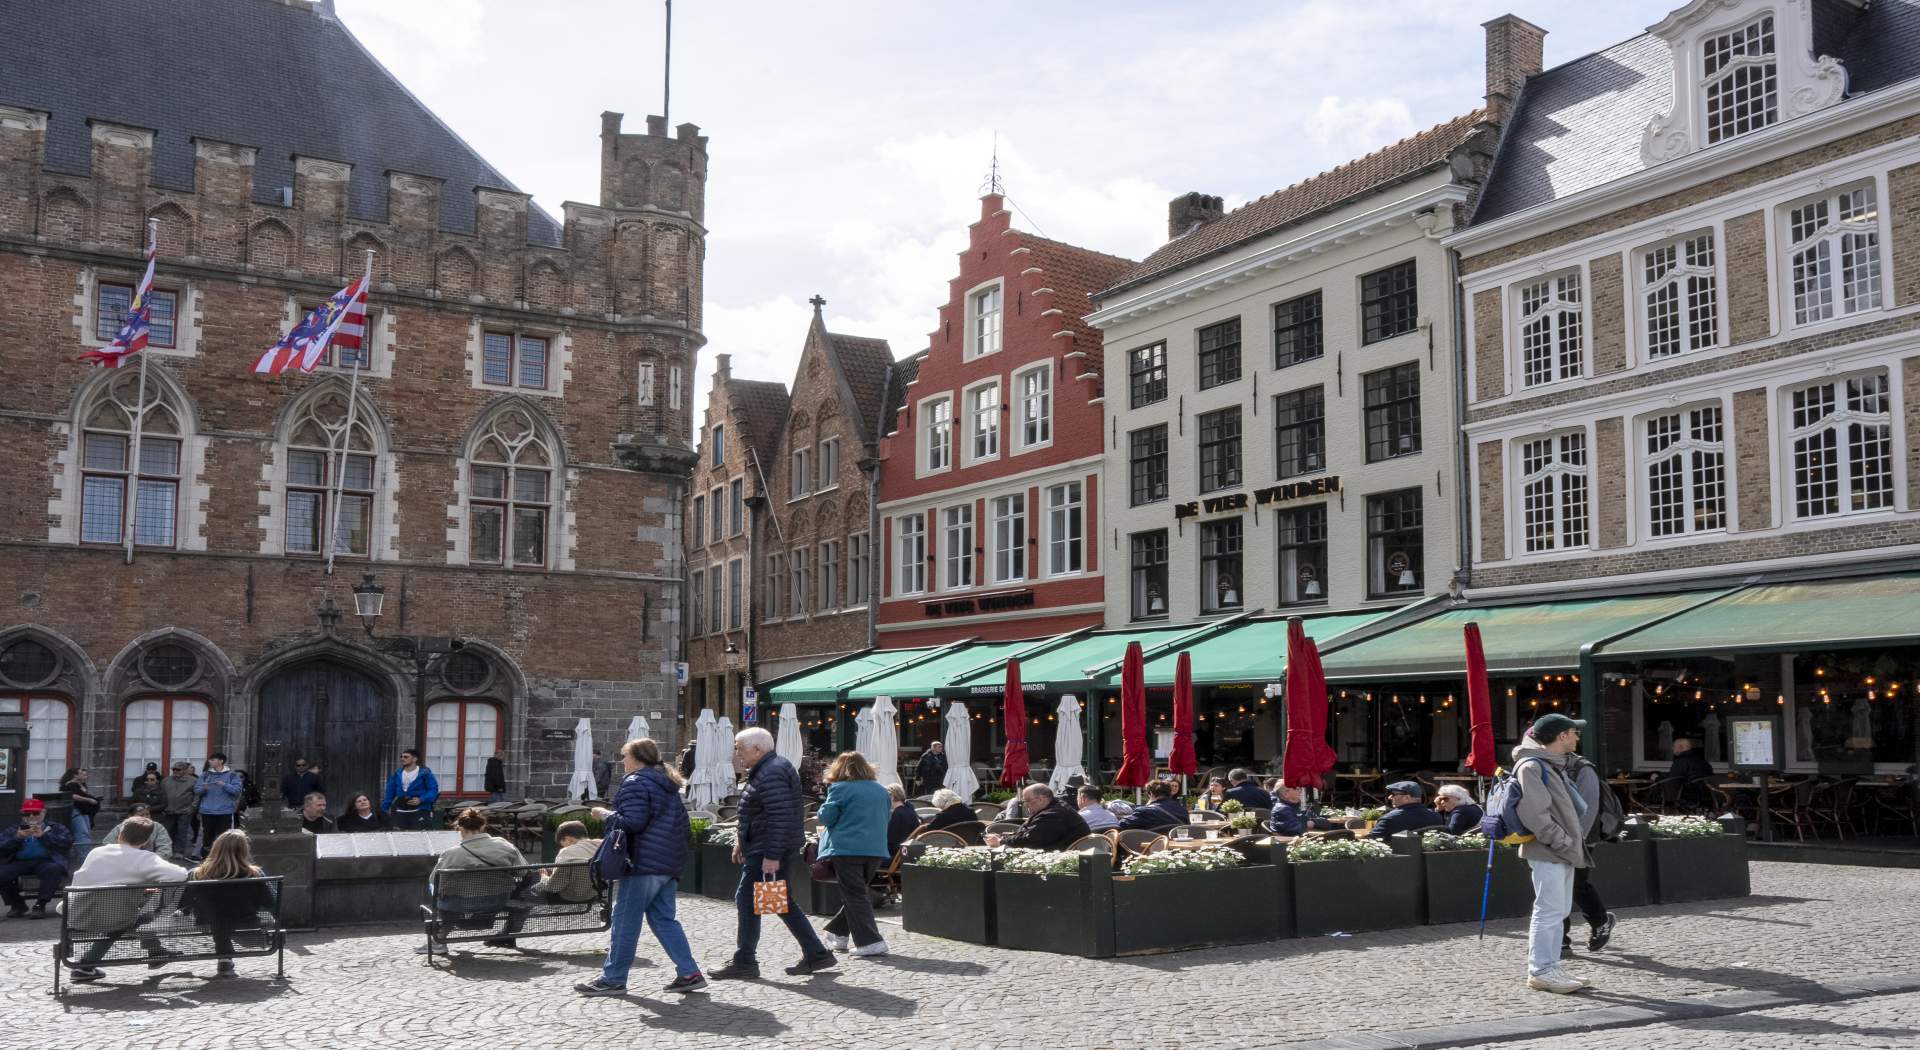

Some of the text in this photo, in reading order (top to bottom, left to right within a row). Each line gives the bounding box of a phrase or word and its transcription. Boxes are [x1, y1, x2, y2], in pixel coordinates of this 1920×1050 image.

[1175, 475, 1343, 519] DE VIER WINDEN
[970, 685, 999, 694] BRASSERIE
